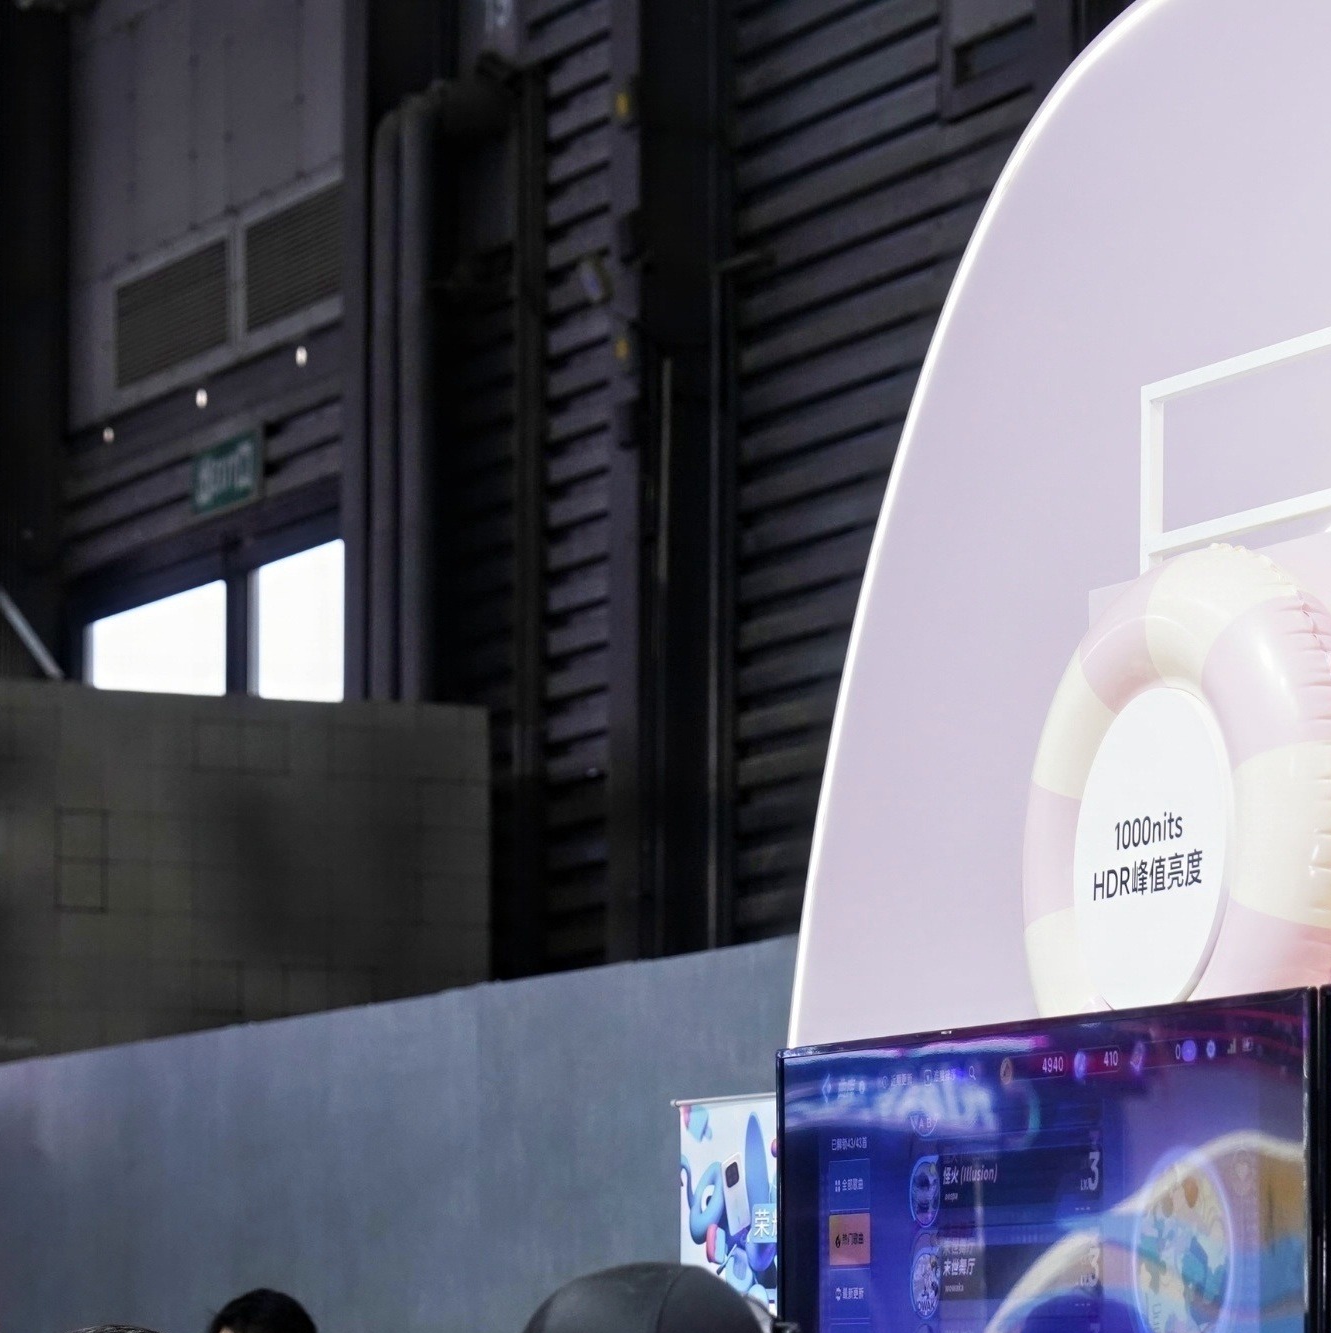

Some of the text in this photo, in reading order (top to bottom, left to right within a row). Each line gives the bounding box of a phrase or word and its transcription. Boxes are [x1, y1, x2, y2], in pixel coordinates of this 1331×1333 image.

[1115, 811, 1183, 851] 1000nits
[1093, 848, 1203, 901] HDR峰值亮度
[1042, 1056, 1064, 1073] 4940
[1103, 1050, 1119, 1066] 410
[942, 1164, 998, 1186] 怪火 (Illusion)
[841, 1178, 864, 1192] 全部歌曲
